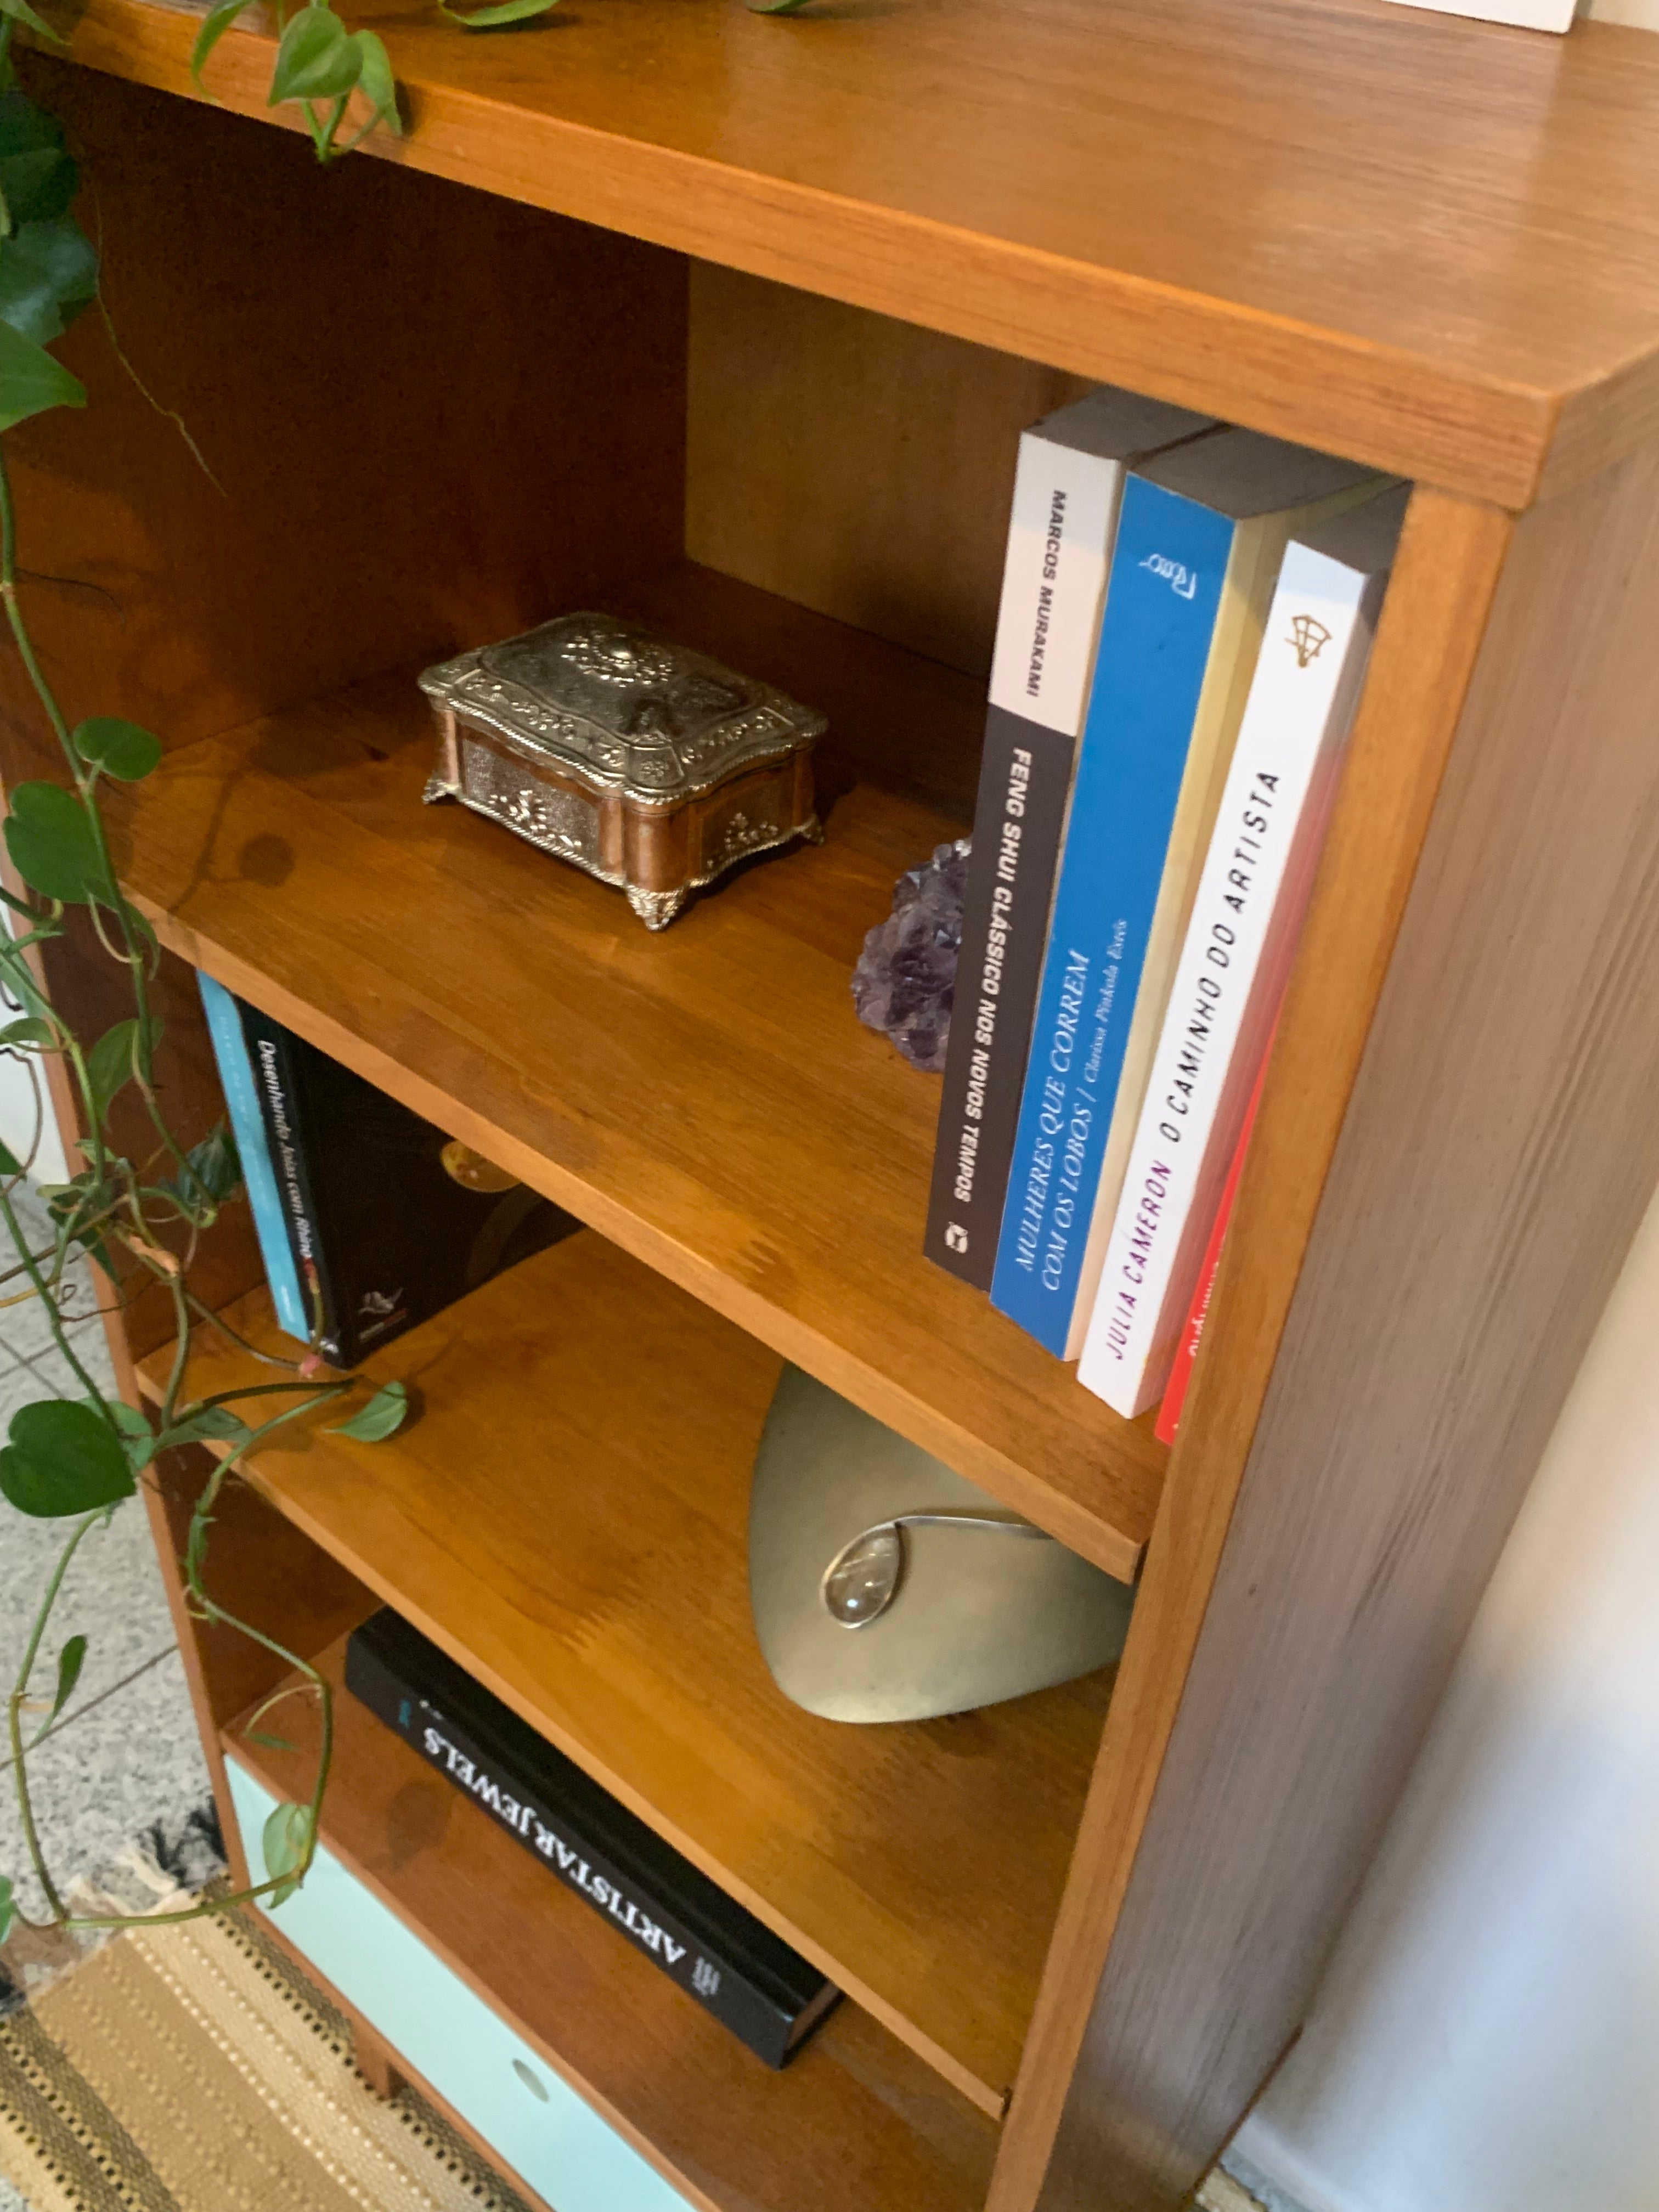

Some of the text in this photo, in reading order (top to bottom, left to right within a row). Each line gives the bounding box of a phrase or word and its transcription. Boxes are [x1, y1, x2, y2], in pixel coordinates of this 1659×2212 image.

[1026, 489, 1067, 697] MARCOS MURAKAMI
[953, 747, 1033, 1203] FENG SHUI CLÁSSICO NOS NOVOS TEMPOS
[1159, 771, 1280, 1143] O CAMINHO DO ARTISTA
[258, 1040, 291, 1140] Desenhando
[288, 1183, 303, 1215] com
[1015, 949, 1090, 1272] MULHERES QUE CORREM
[1053, 1192, 1075, 1229] OS
[1059, 1102, 1092, 1193] LOBOS
[1042, 1228, 1067, 1291] COM
[1106, 1160, 1173, 1361] JULIA CAMERON
[423, 1726, 687, 1963] ARTISTAR JEWELS
